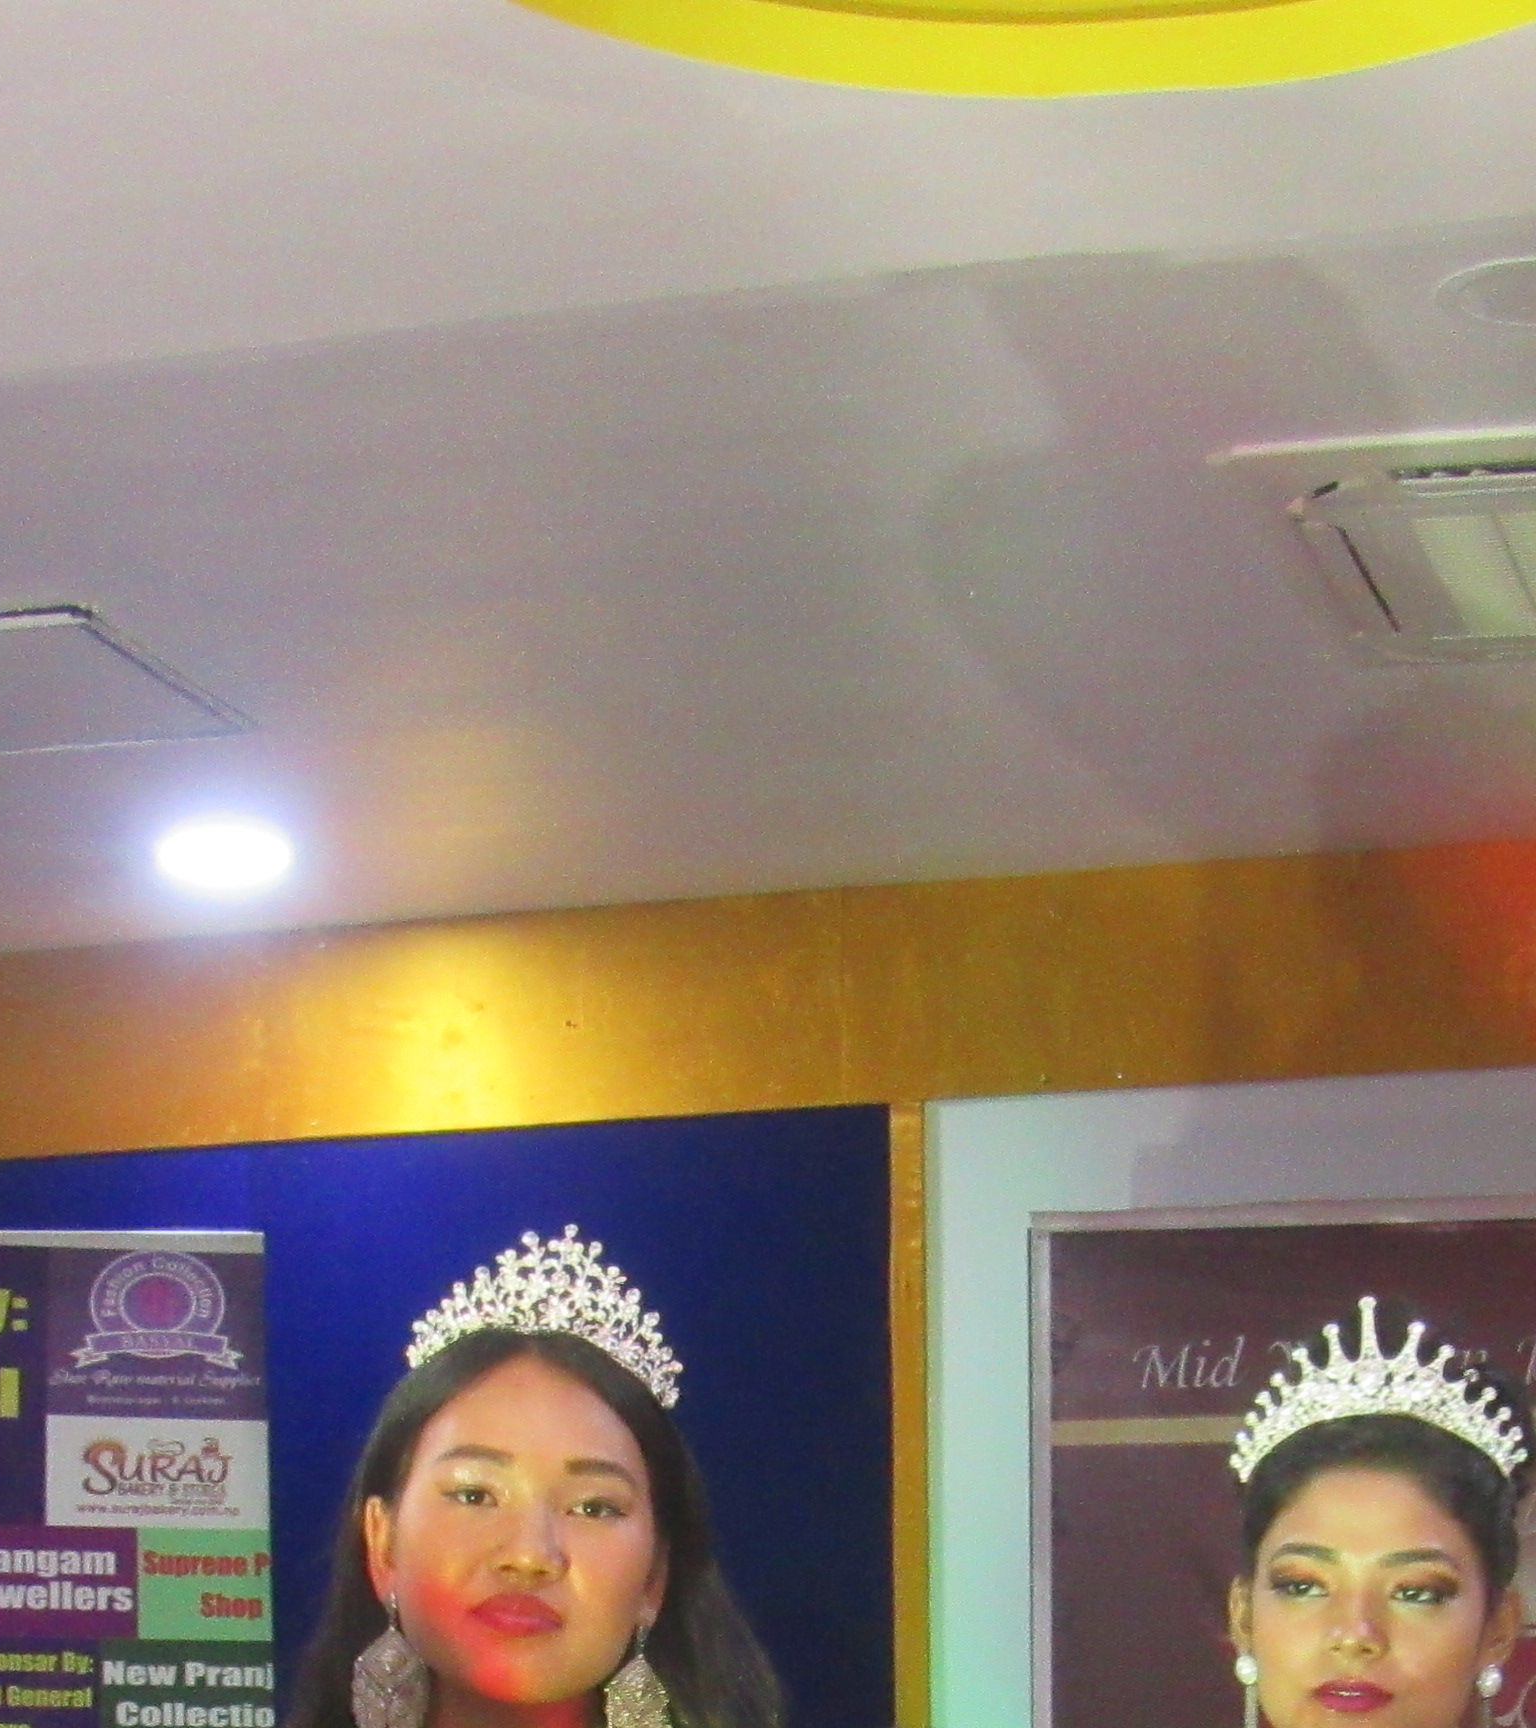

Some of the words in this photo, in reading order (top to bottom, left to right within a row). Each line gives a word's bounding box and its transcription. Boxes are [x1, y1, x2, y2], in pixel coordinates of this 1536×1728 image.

[1132, 1335, 1246, 1390] Mid
[82, 1437, 233, 1496] SURAJ
[200, 1591, 263, 1621] Shop
[101, 1659, 177, 1687] New
[5, 1685, 94, 1708] General
